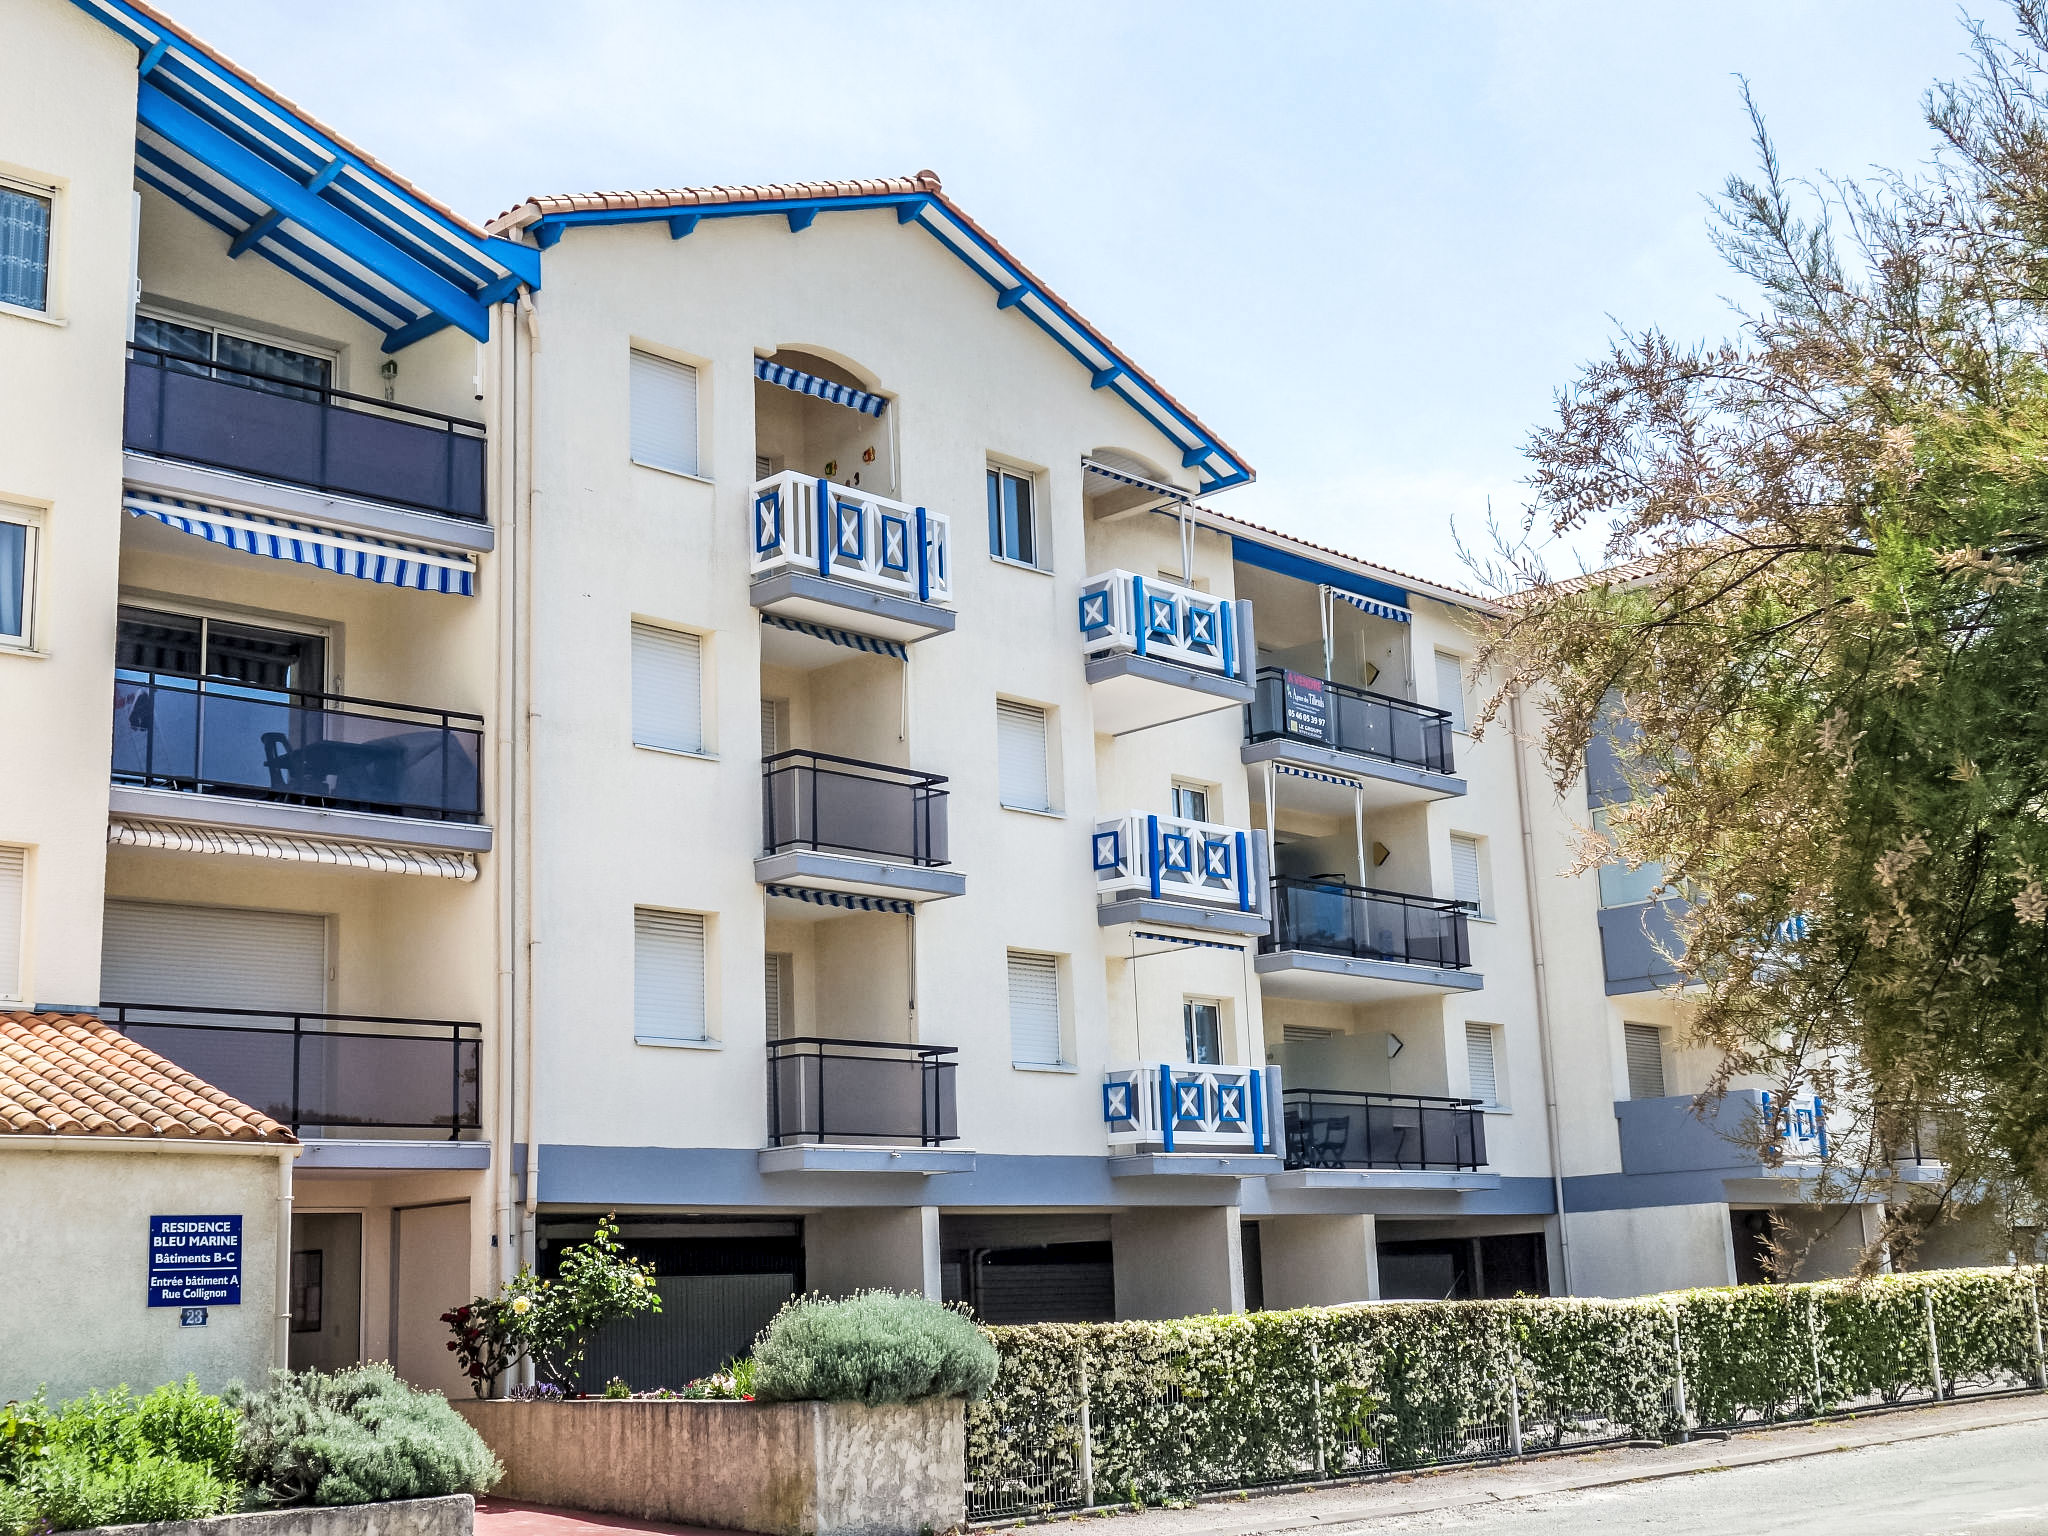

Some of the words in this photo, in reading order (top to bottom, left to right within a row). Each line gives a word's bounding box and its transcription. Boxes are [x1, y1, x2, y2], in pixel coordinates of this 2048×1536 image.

[1294, 674, 1322, 692] VENDRE
[161, 1221, 231, 1233] RESIDENCE
[153, 1236, 186, 1247] BLEU
[189, 1235, 238, 1246] MARINE
[155, 1252, 211, 1263] Bâtiments
[213, 1252, 235, 1262] B-C
[150, 1276, 183, 1287] Entrée
[185, 1275, 229, 1286] bâtiment
[229, 1275, 239, 1285] A
[162, 1289, 181, 1299] Rue
[183, 1288, 227, 1300] Collignon
[185, 1309, 203, 1324] 23
